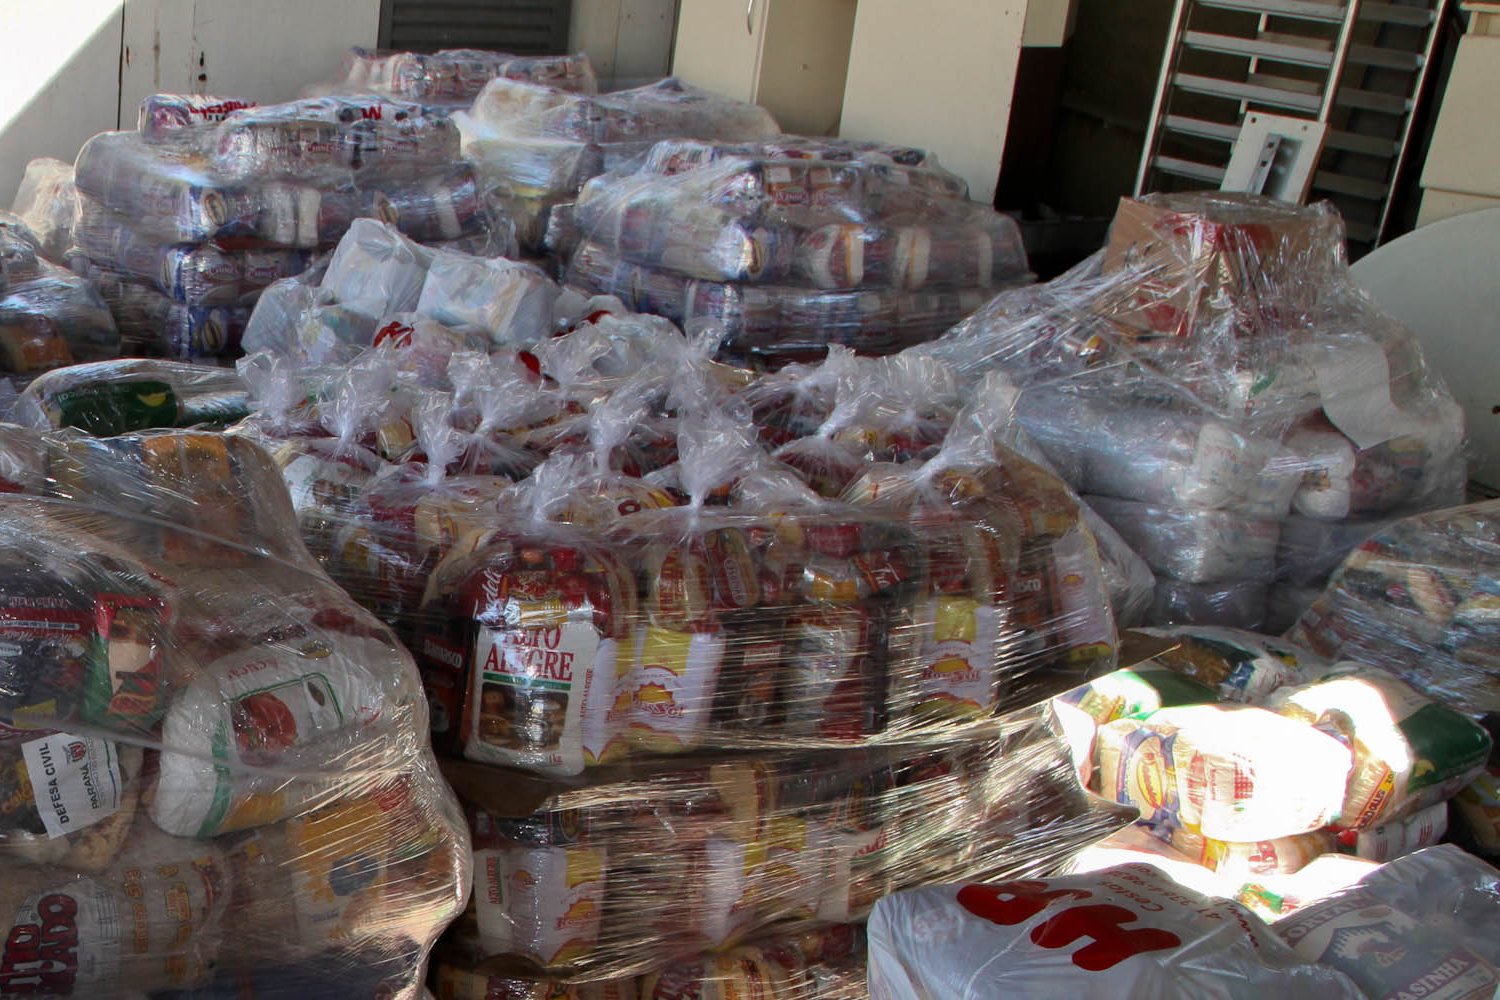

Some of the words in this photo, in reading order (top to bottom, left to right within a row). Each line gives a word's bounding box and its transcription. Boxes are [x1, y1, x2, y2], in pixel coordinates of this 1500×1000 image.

[484, 643, 575, 682] ALEGRE
[38, 741, 56, 775] CIVIL
[46, 775, 70, 825] DEFESA
